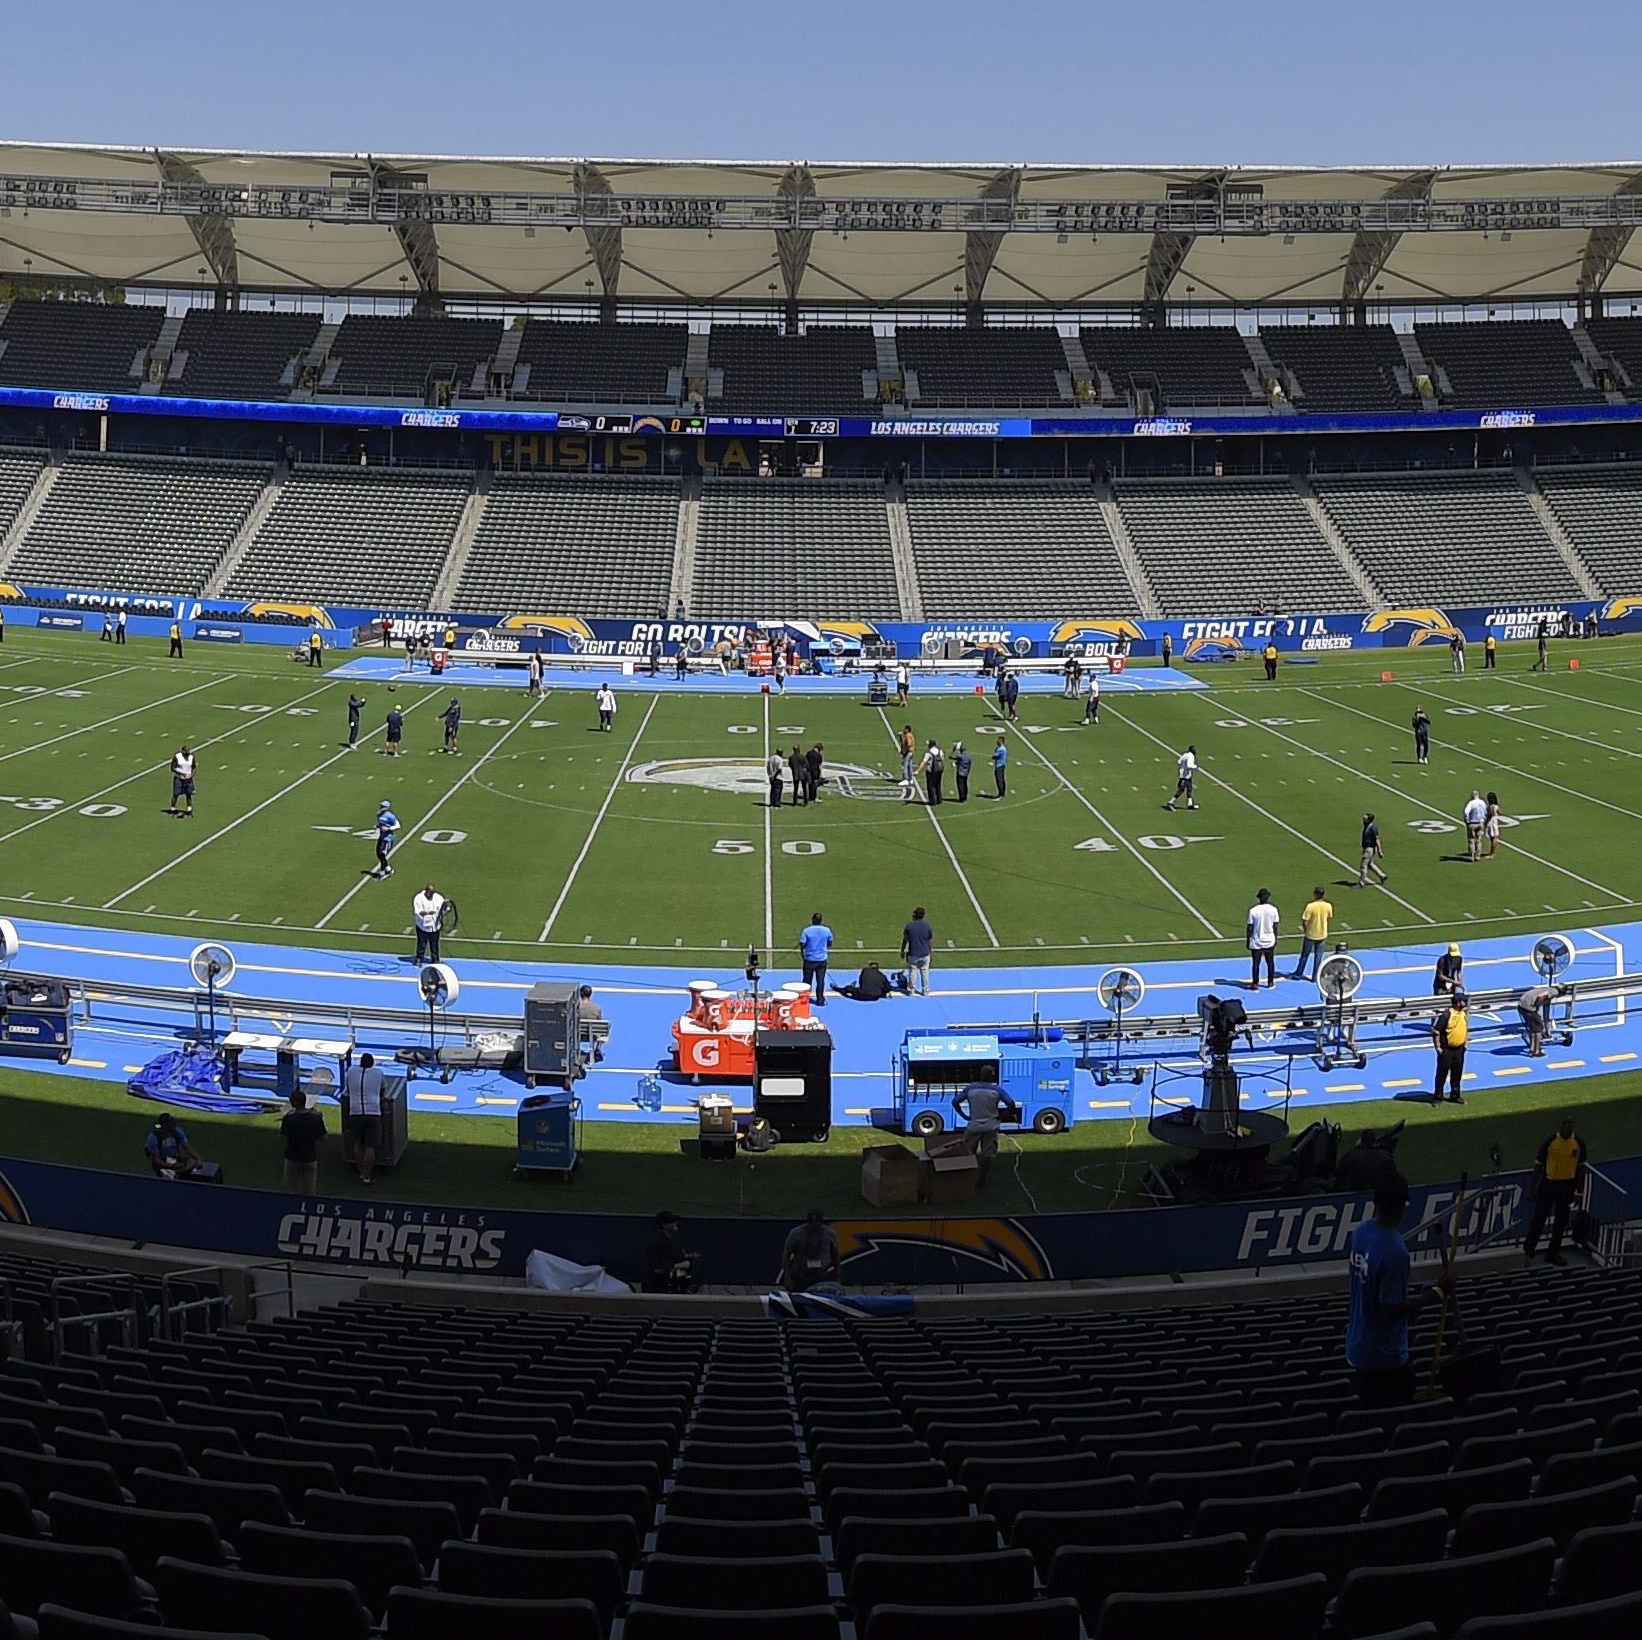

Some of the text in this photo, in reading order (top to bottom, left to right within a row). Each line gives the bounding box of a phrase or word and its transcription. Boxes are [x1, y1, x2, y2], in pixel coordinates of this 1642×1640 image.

[53, 395, 111, 411] CHARGERS
[401, 413, 461, 427] CHARGERS
[595, 416, 606, 430] 0
[670, 418, 681, 432] 0
[810, 421, 835, 434] 7:23
[1480, 413, 1536, 428] CHARGERS
[870, 422, 999, 436] LOS ANGELES CHARGERS
[1133, 422, 1192, 436] CHARGERS
[485, 434, 751, 471] THIS IS LA
[174, 601, 203, 622] LA
[631, 622, 664, 641] GO
[617, 640, 645, 655] FOR
[1301, 637, 1352, 651] CHARGERS
[708, 1004, 720, 1017] G
[778, 1005, 791, 1017] G
[692, 1038, 721, 1067] G
[300, 1201, 486, 1227] LOS ANGELES
[1237, 1200, 1377, 1261] FIGH
[277, 1213, 506, 1270] CHARGERS
